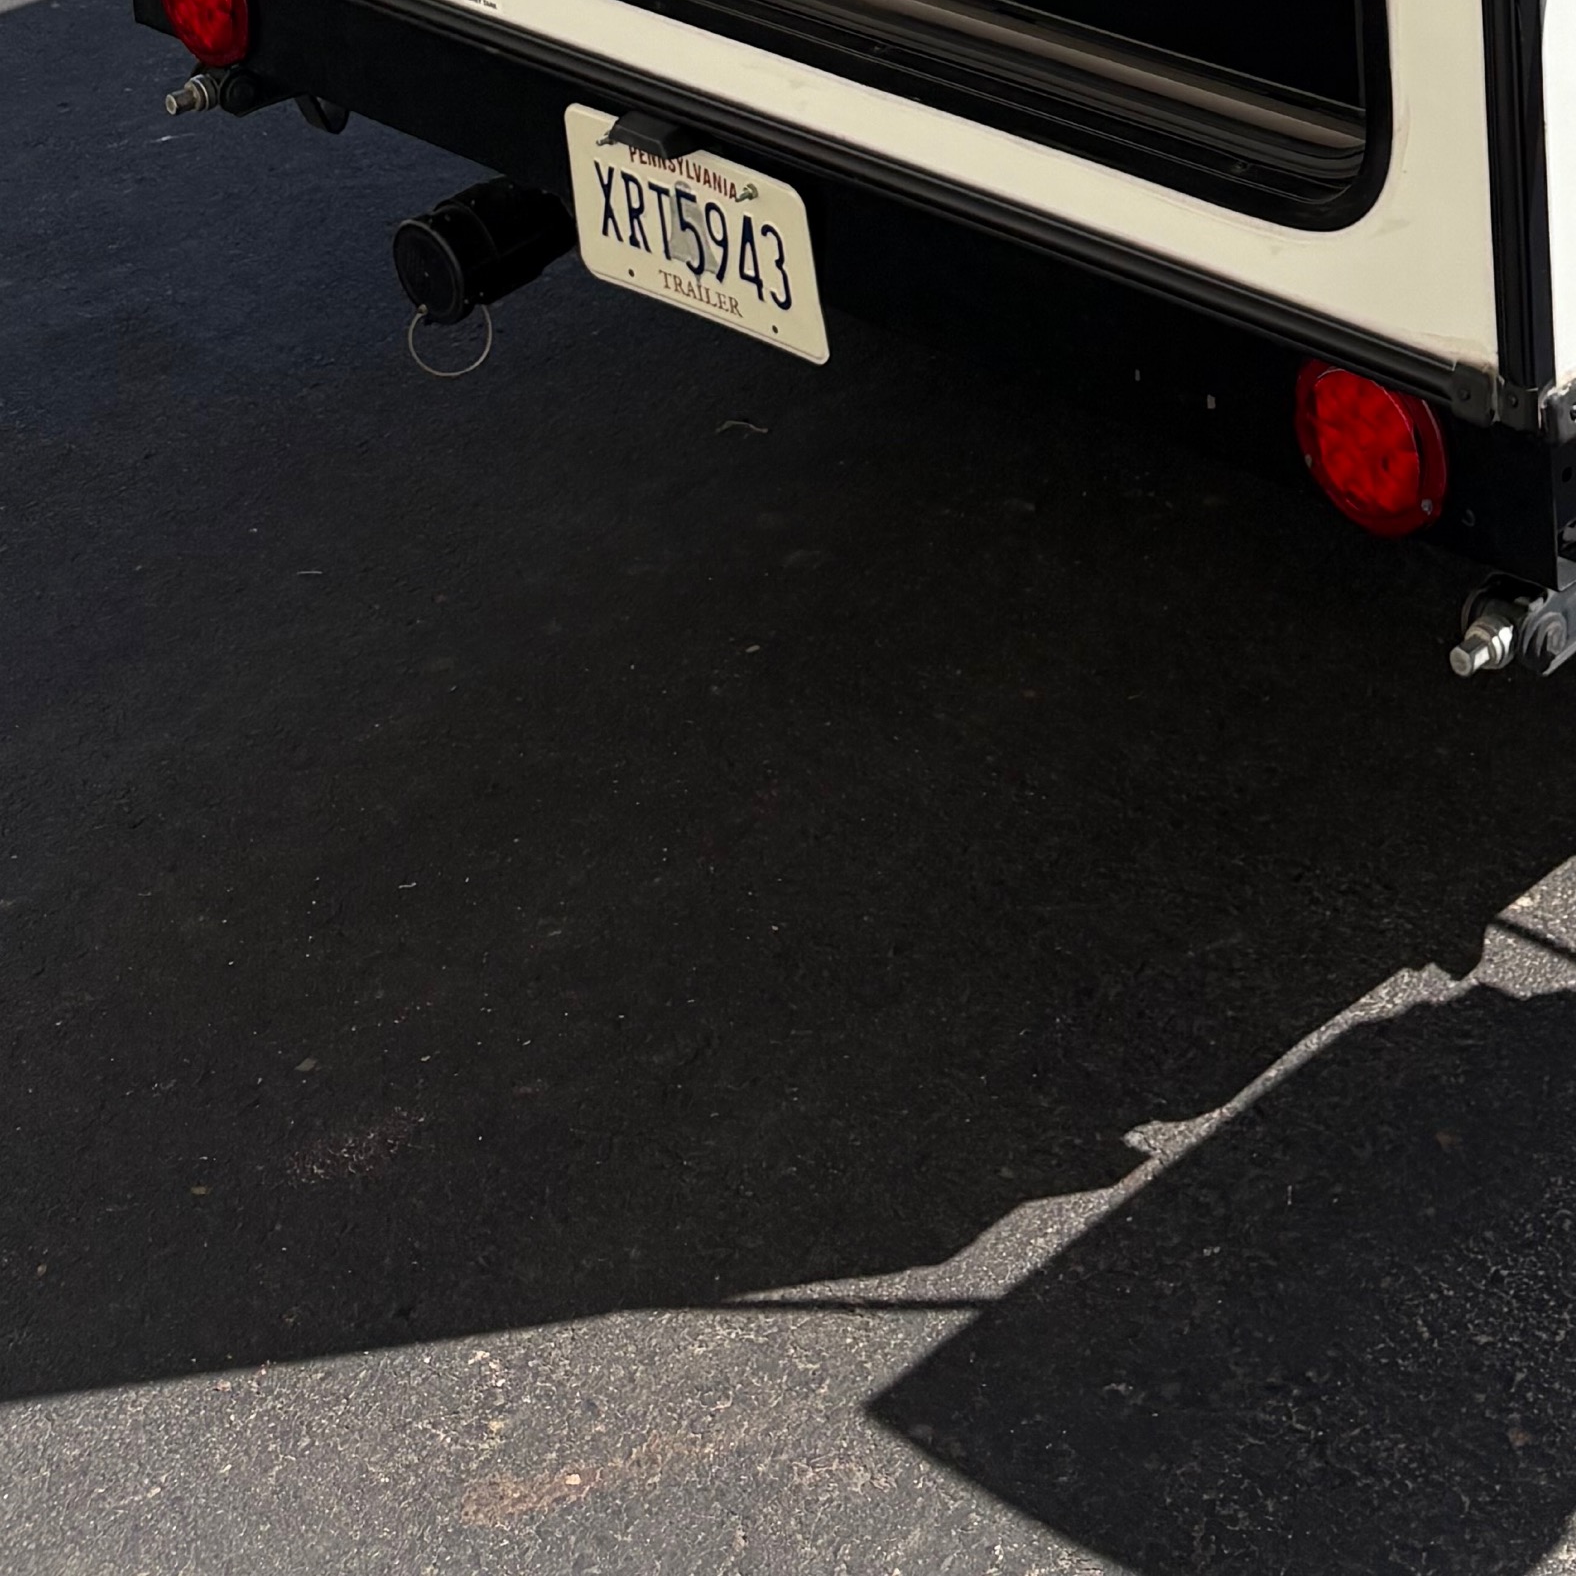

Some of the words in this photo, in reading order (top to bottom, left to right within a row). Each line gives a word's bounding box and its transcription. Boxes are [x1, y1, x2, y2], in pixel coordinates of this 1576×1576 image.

[629, 145, 737, 200] PENNSYLVANIA
[593, 159, 793, 311] XRT5943
[658, 269, 744, 318] TRAILER
